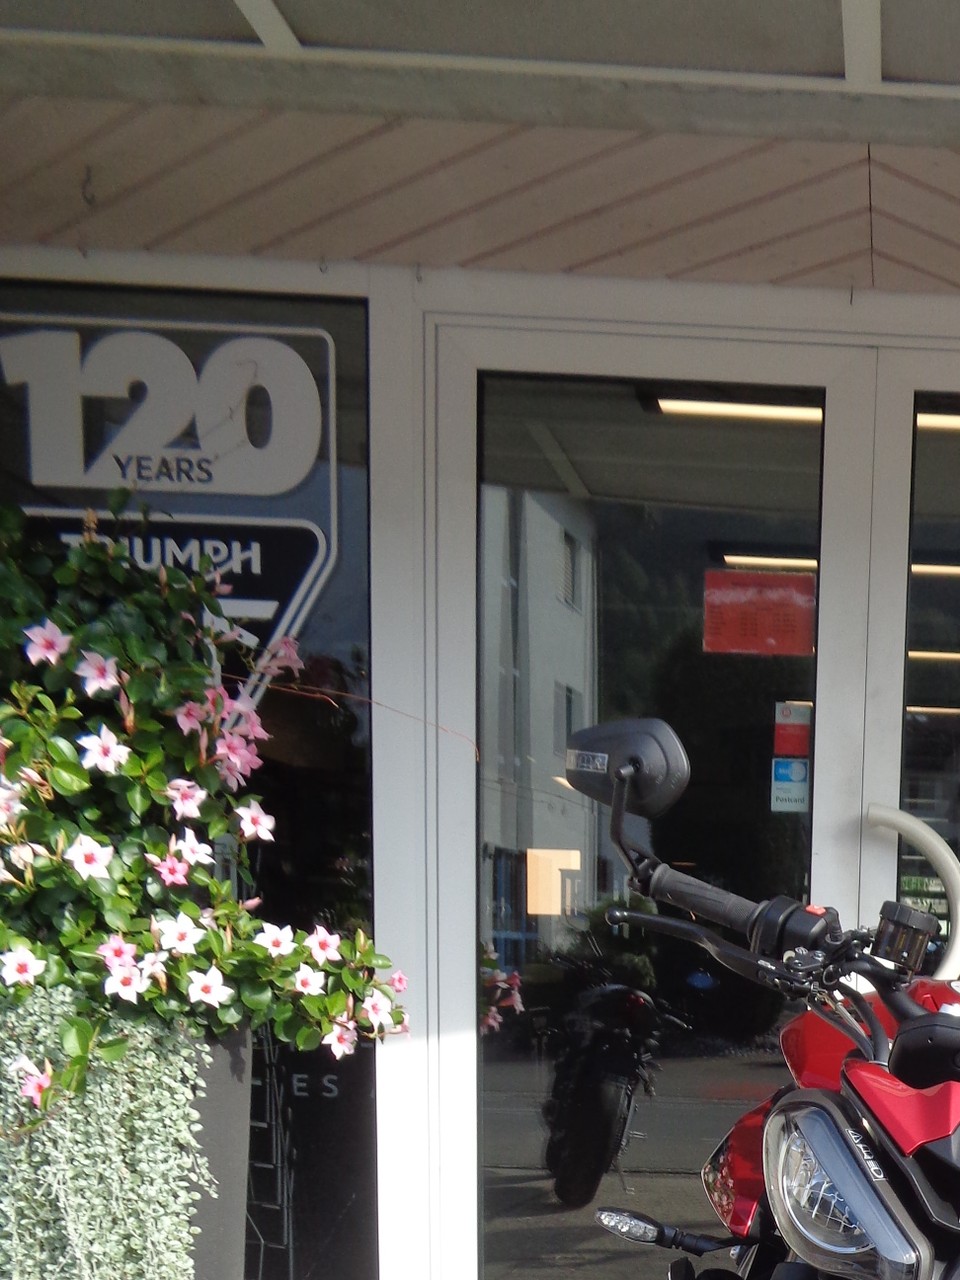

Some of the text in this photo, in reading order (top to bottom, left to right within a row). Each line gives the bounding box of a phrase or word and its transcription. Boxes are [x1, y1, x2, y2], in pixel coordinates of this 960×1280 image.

[0, 329, 323, 497] 120
[112, 453, 214, 484] YEARS
[59, 532, 263, 582] UMPH
